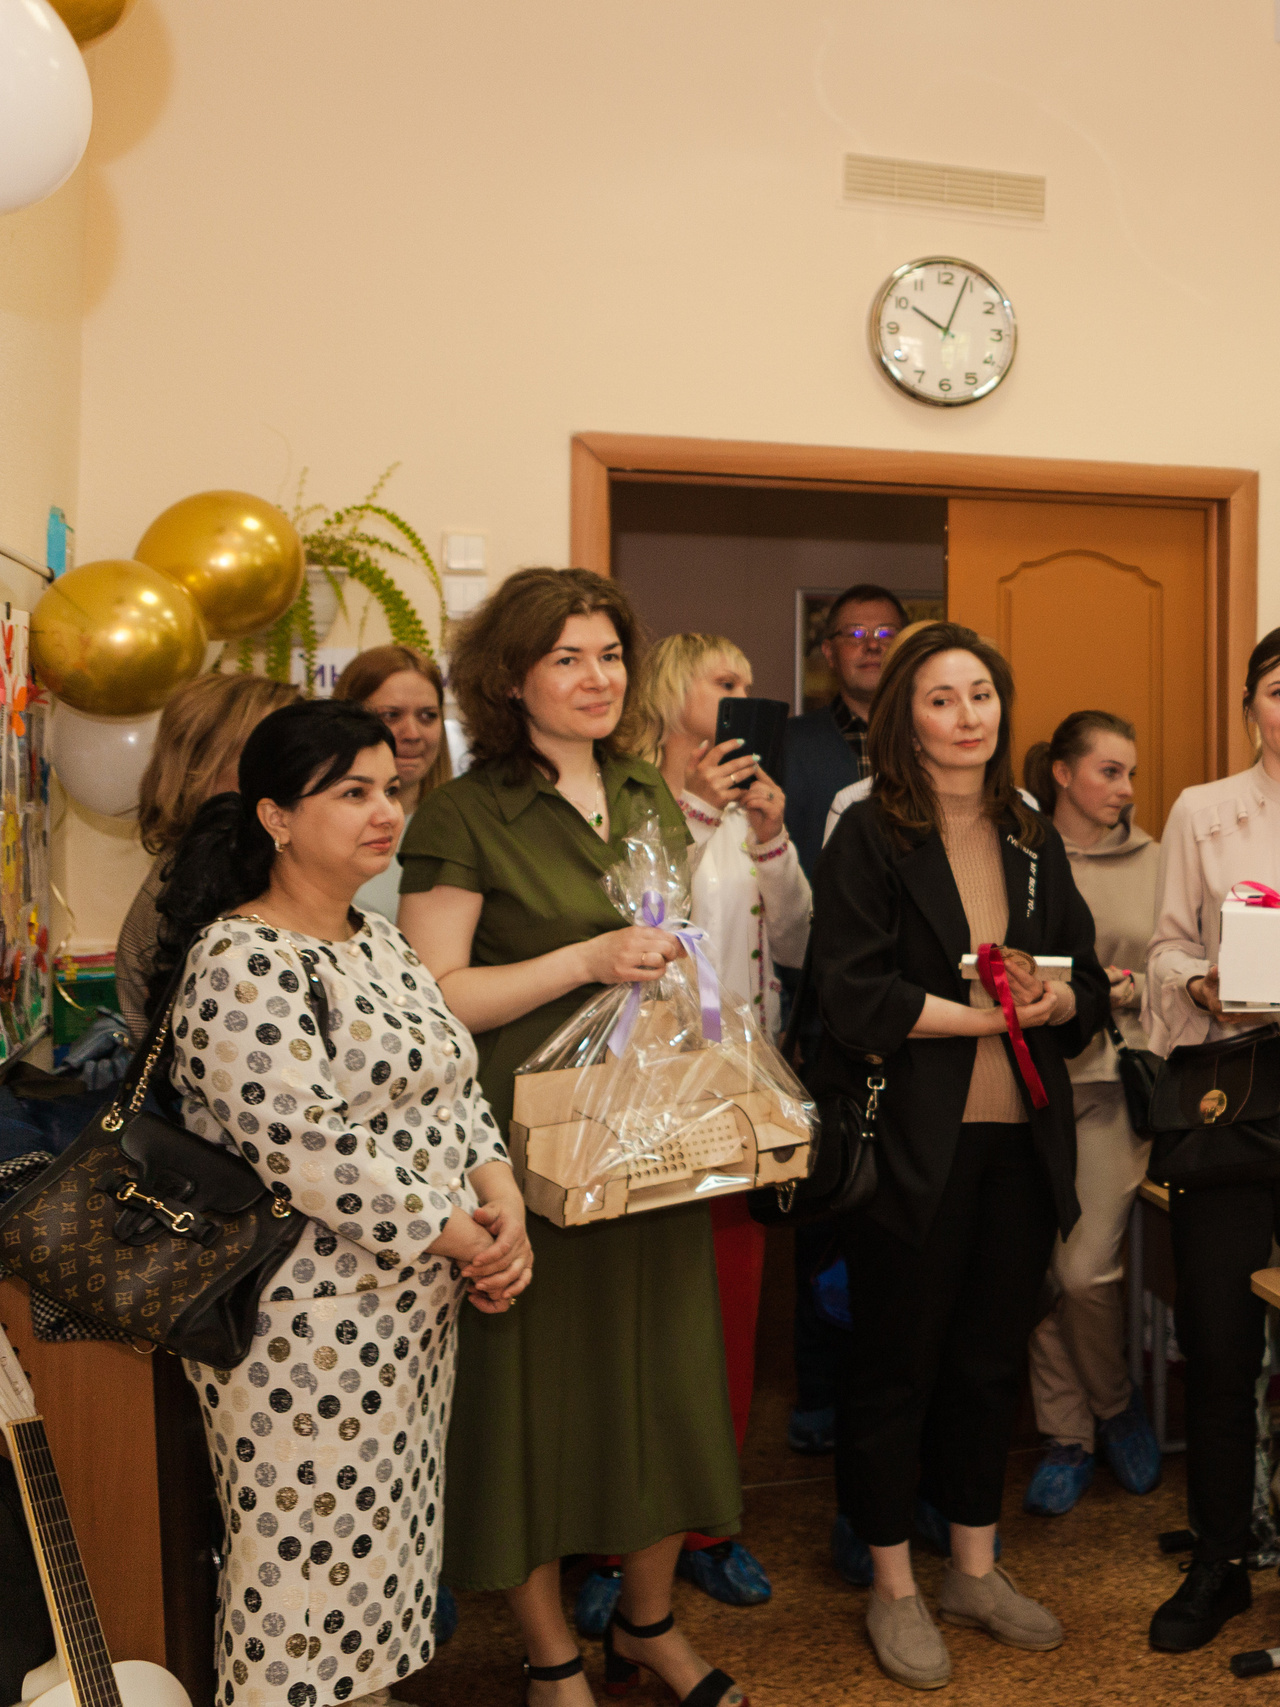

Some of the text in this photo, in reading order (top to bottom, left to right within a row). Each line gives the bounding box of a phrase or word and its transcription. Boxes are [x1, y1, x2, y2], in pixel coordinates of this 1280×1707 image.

[938, 271, 954, 285] 12
[914, 279, 924, 291] 11
[895, 296, 909, 309] 10
[983, 302, 995, 315] 2
[886, 321, 899, 334] 9
[990, 329, 1003, 342] 3
[913, 370, 926, 383] 7
[964, 372, 978, 386] 5
[938, 378, 952, 392] 6
